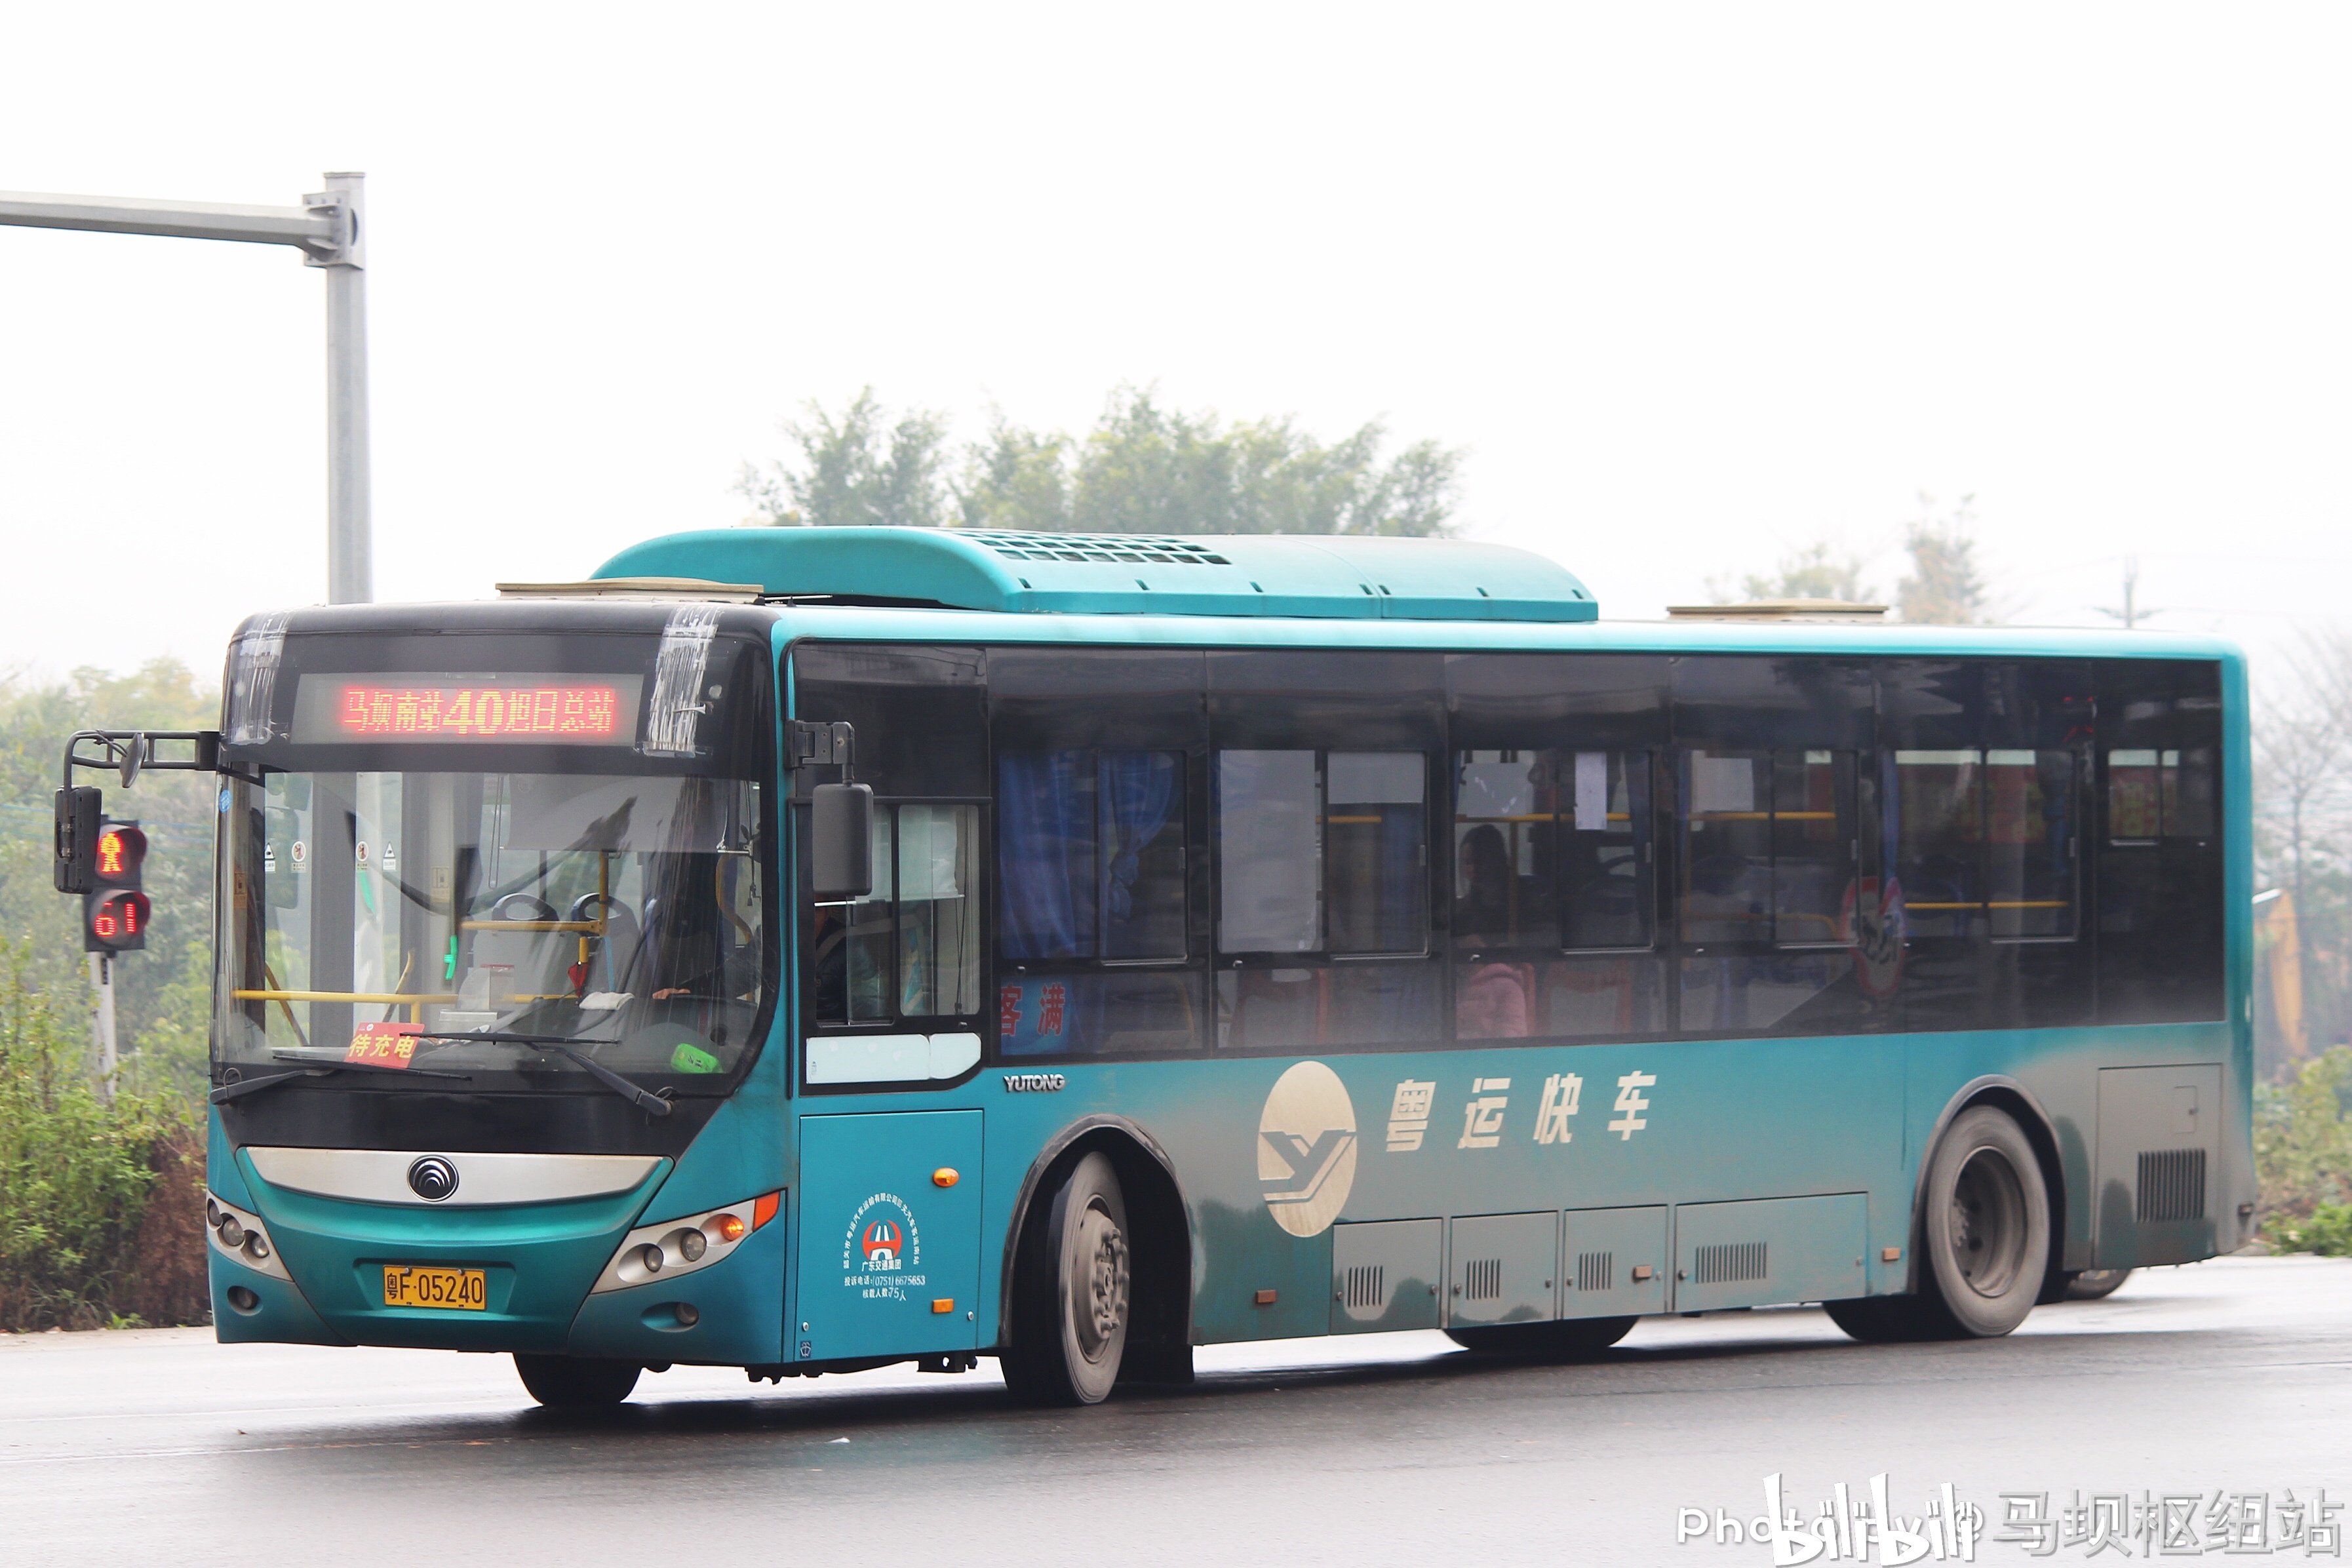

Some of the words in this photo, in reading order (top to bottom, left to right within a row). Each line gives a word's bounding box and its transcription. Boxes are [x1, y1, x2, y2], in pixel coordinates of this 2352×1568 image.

[1000, 982, 1066, 1036] 客满
[349, 1033, 416, 1059] 待充电
[1004, 1073, 1065, 1093] YUTONG
[1386, 1070, 1656, 1152] 粤运快车
[861, 1258, 902, 1272] 广东交通集团
